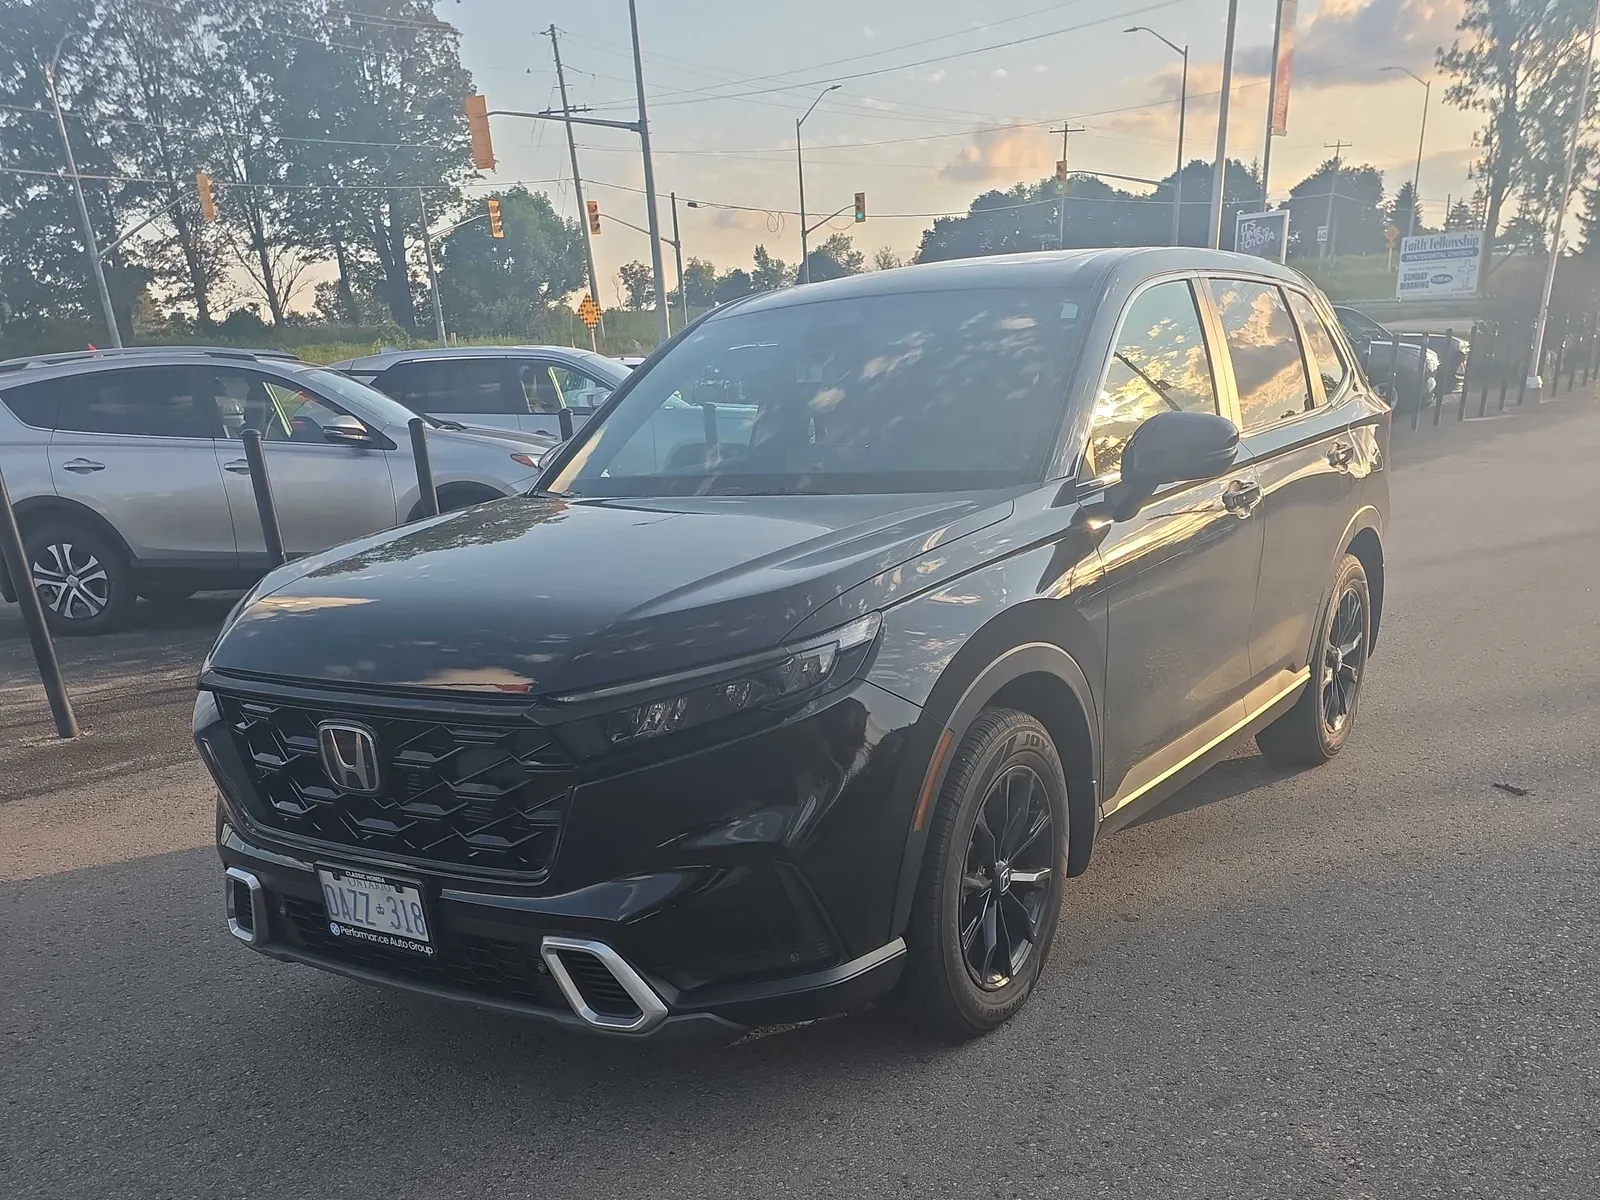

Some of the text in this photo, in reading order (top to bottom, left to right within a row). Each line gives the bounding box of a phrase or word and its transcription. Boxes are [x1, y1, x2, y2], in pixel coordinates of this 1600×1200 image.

[1240, 231, 1275, 250] TOYOTA
[1241, 226, 1262, 241] TIME
[1404, 233, 1479, 253] Faith Fellowship
[1406, 251, 1447, 261] PENTECOSTAL
[345, 870, 387, 884] CLASSIC HONDA
[347, 877, 392, 893] ONTARIO
[323, 883, 426, 936] DAZZ 318
[340, 925, 434, 957] Performance Auto Group
